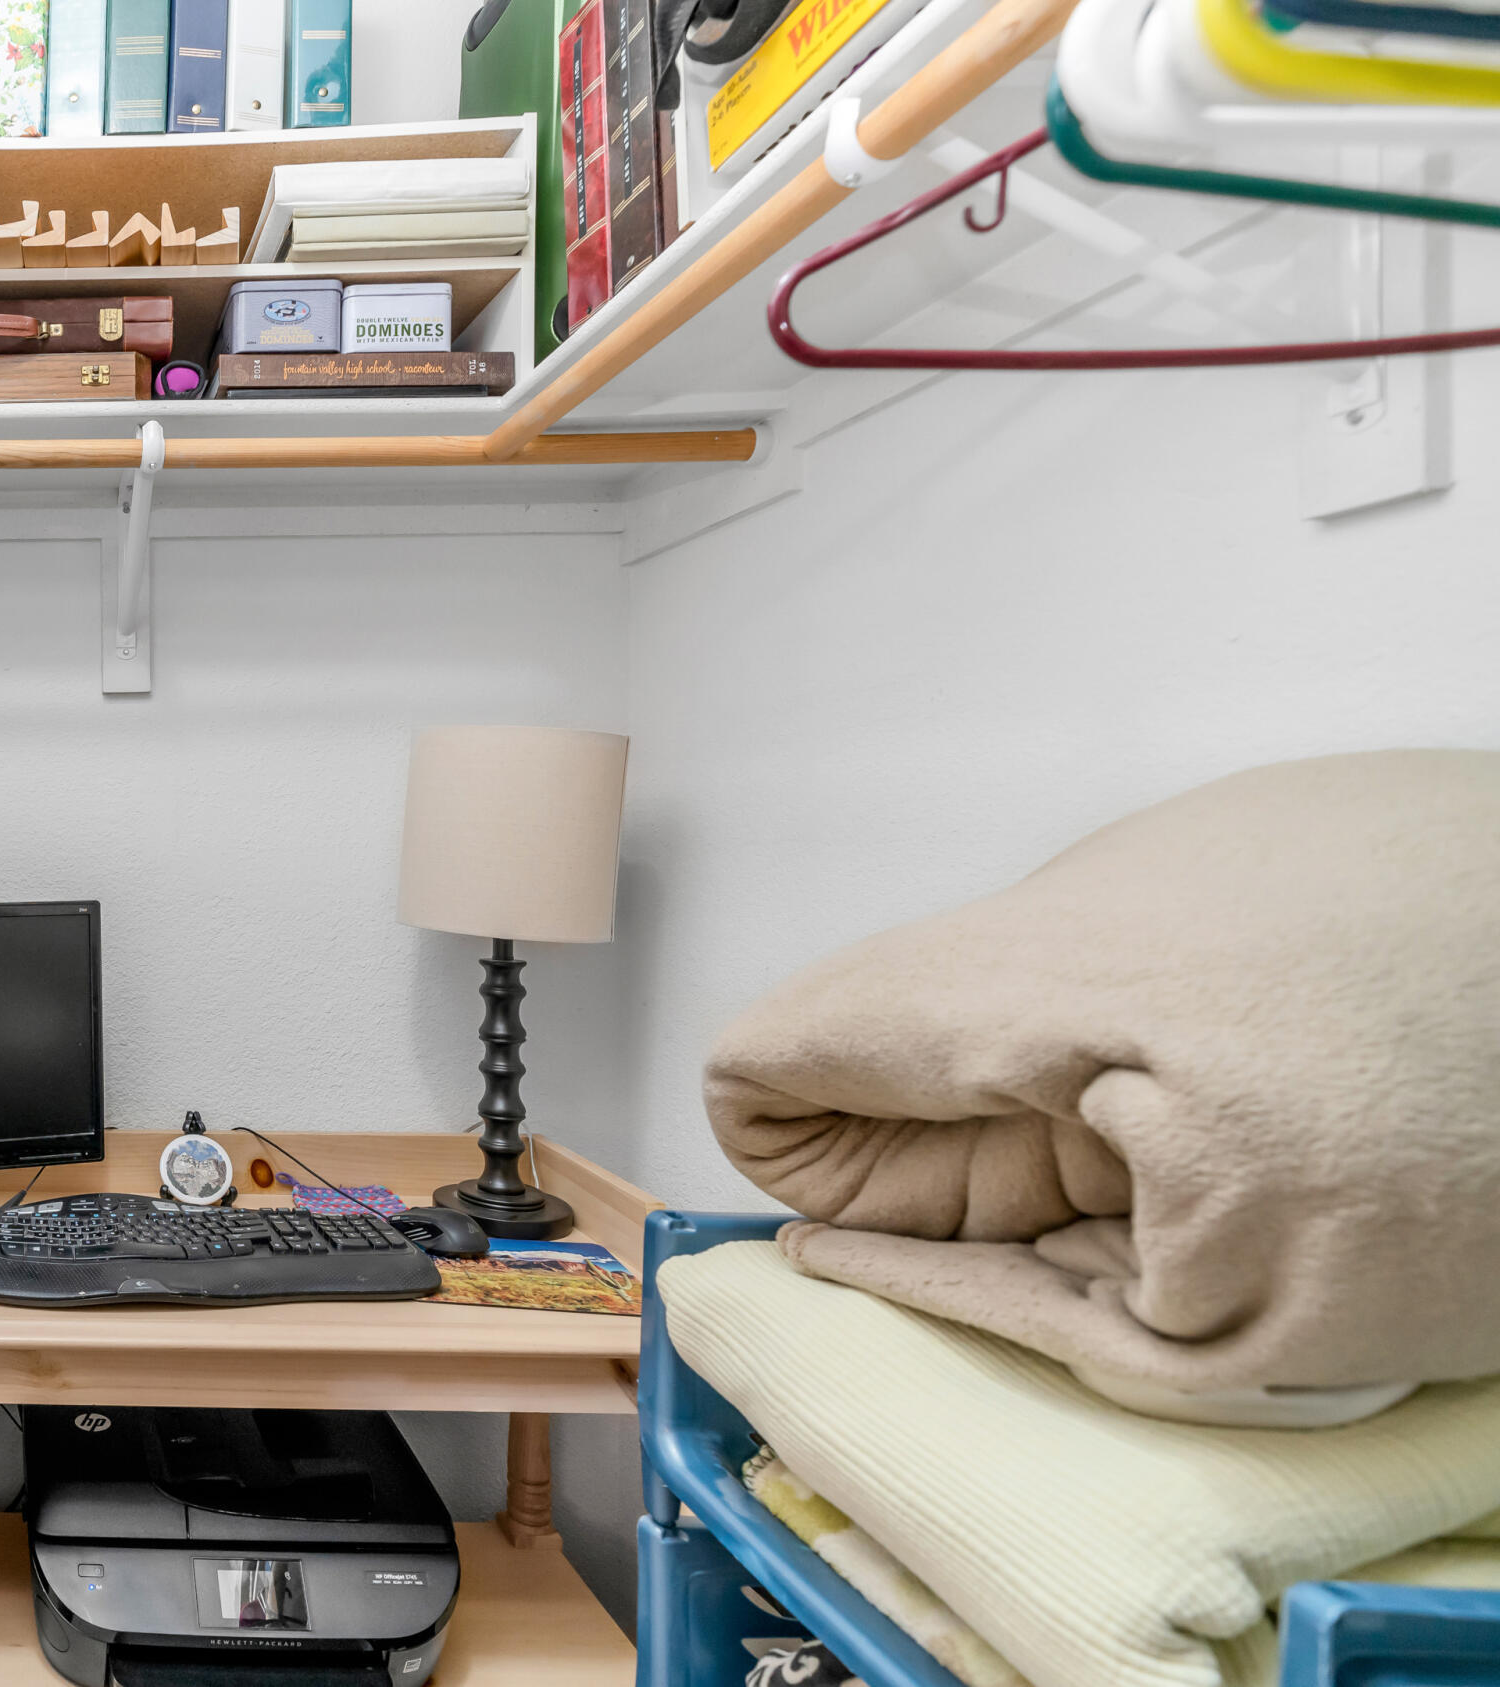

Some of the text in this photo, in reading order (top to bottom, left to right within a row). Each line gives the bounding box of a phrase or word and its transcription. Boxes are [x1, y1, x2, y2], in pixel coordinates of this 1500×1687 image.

[356, 323, 444, 337] DOMINOES
[283, 360, 445, 380] fountain valley high school raconteur
[79, 1413, 107, 1431] hp
